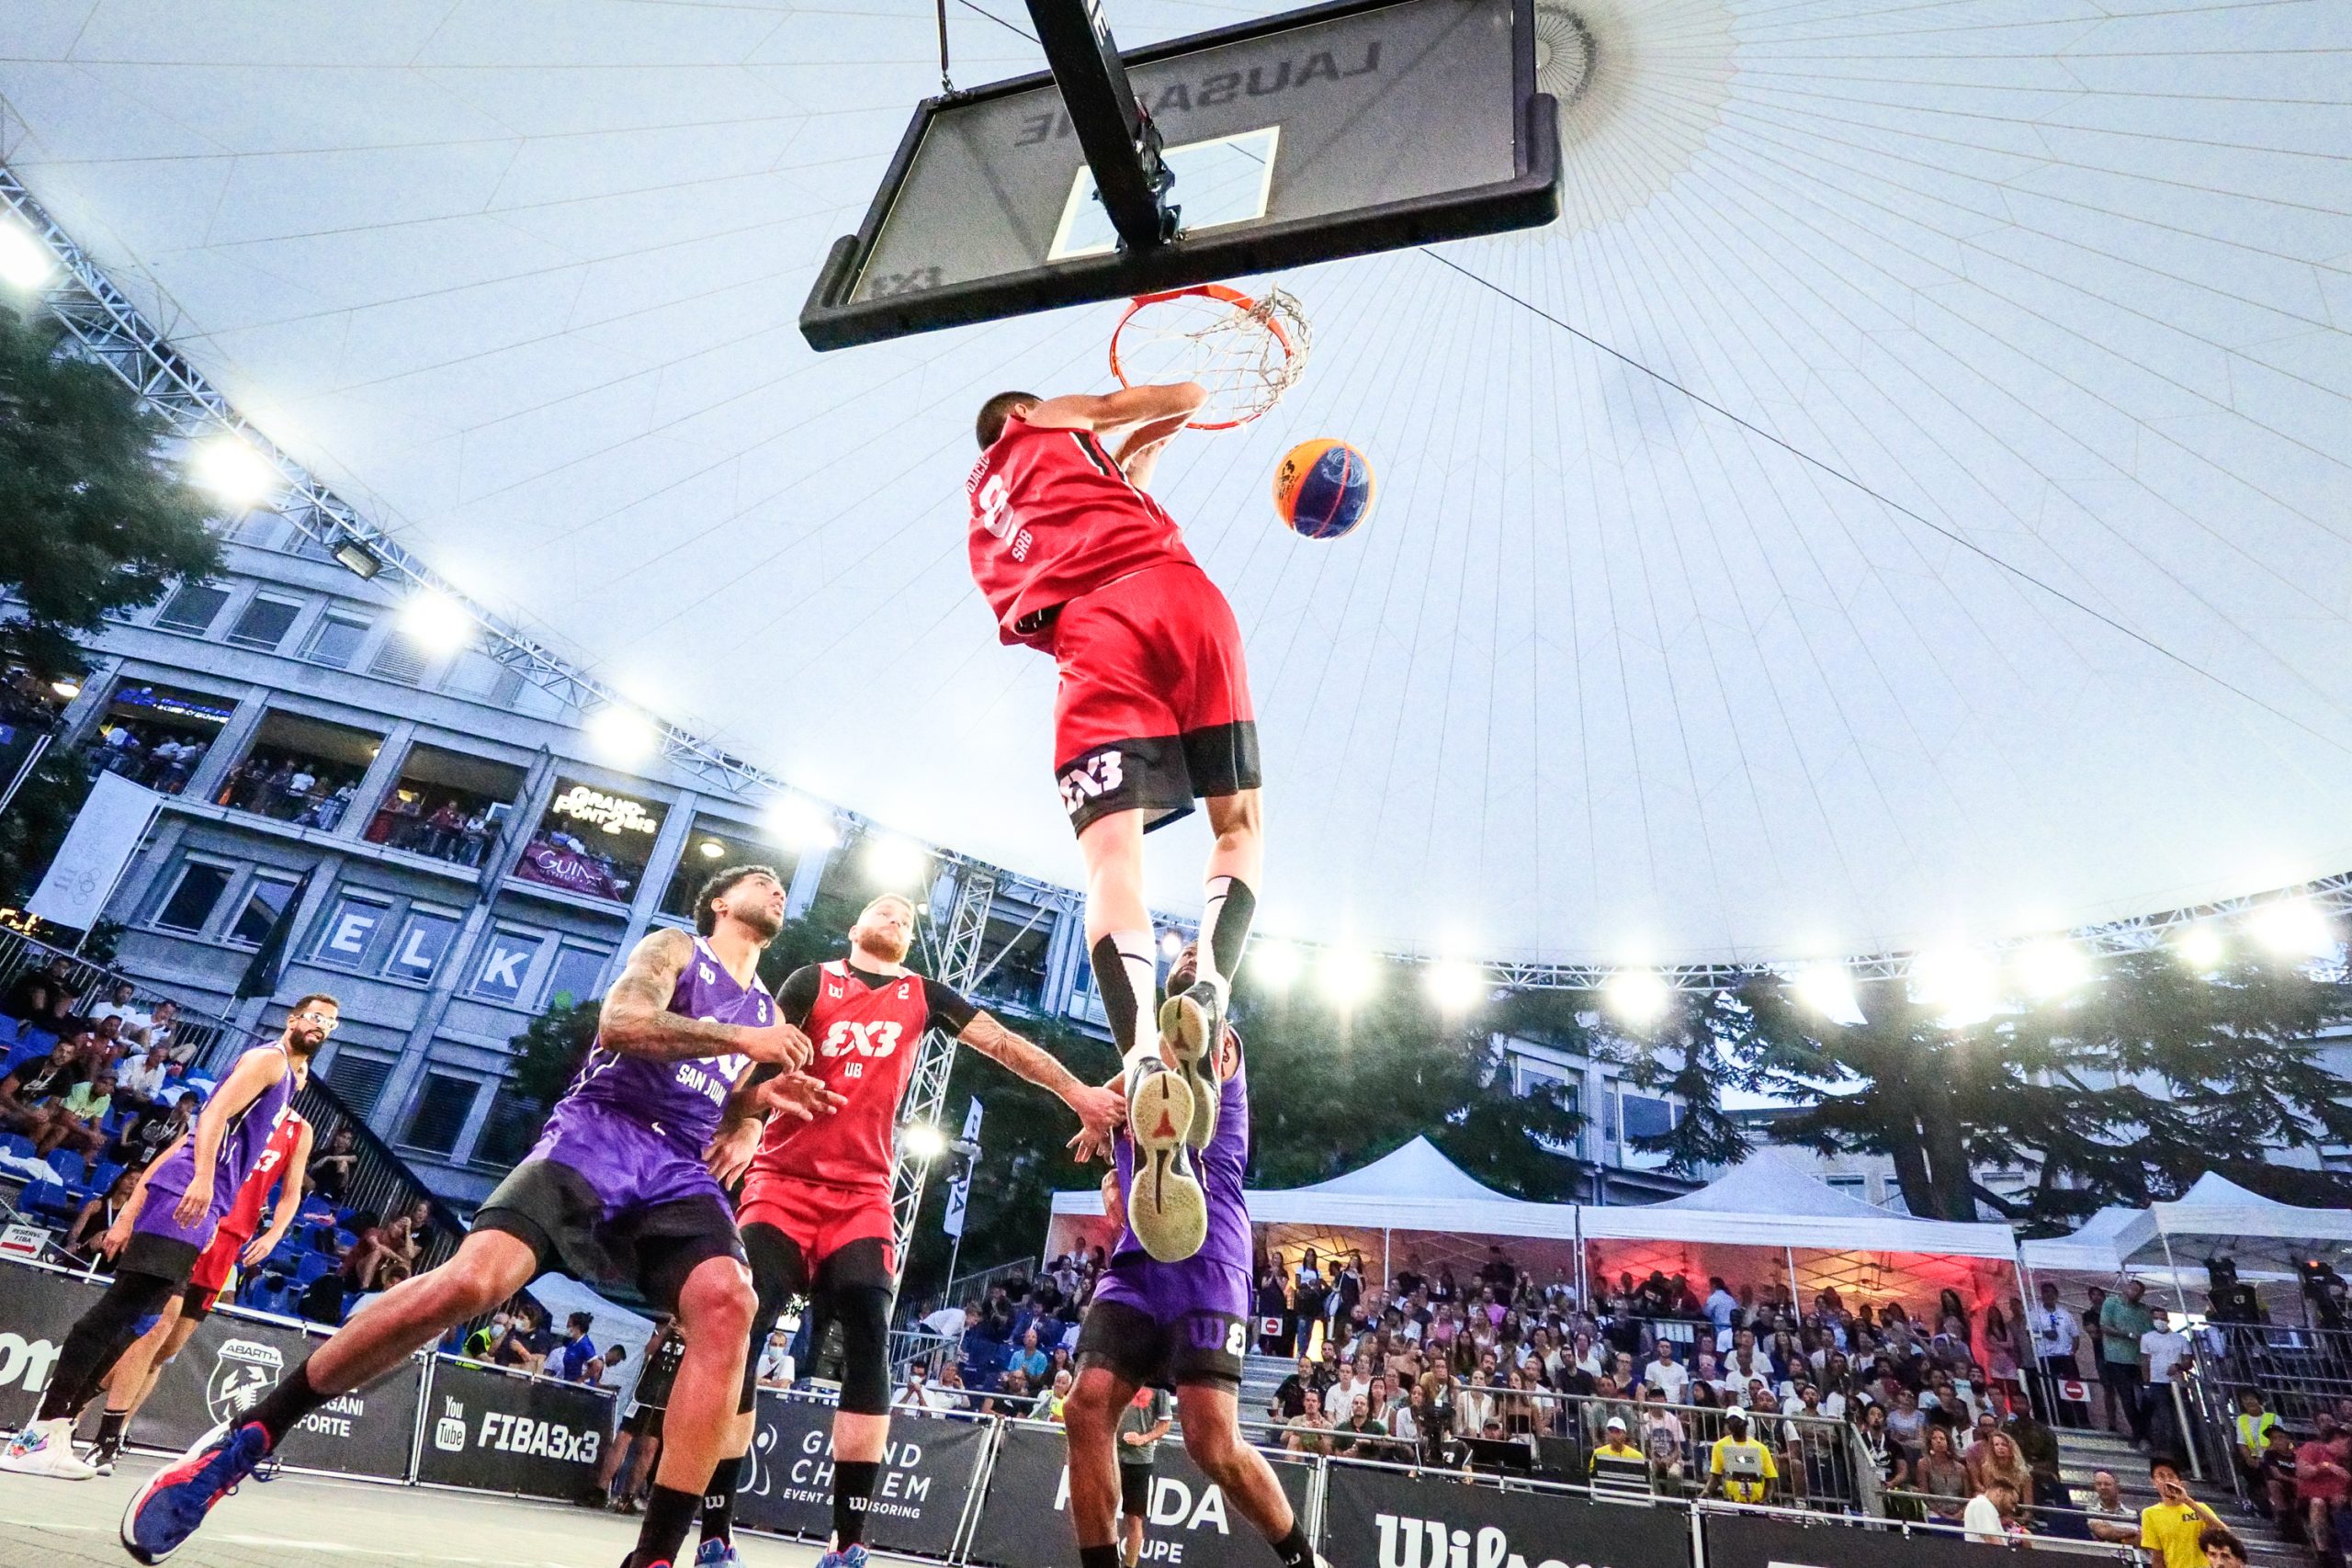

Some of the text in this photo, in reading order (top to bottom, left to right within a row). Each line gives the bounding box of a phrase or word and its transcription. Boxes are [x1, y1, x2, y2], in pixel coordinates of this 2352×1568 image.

[1012, 528, 1032, 562] SRB
[898, 983, 910, 999] 2
[757, 998, 767, 1023] 3
[675, 1064, 707, 1091] SAN
[844, 1062, 863, 1078] UB
[14, 1235, 31, 1244] FIBA
[225, 1343, 278, 1361] ABARTH
[321, 1395, 364, 1416] GANI
[446, 1395, 464, 1418] You
[293, 1414, 351, 1438] FORTE
[439, 1422, 463, 1446] Tube
[478, 1411, 601, 1464] FIBA3x3
[803, 1430, 922, 1469] GND
[791, 1459, 932, 1502] CHEM
[783, 1487, 824, 1504] EVENT
